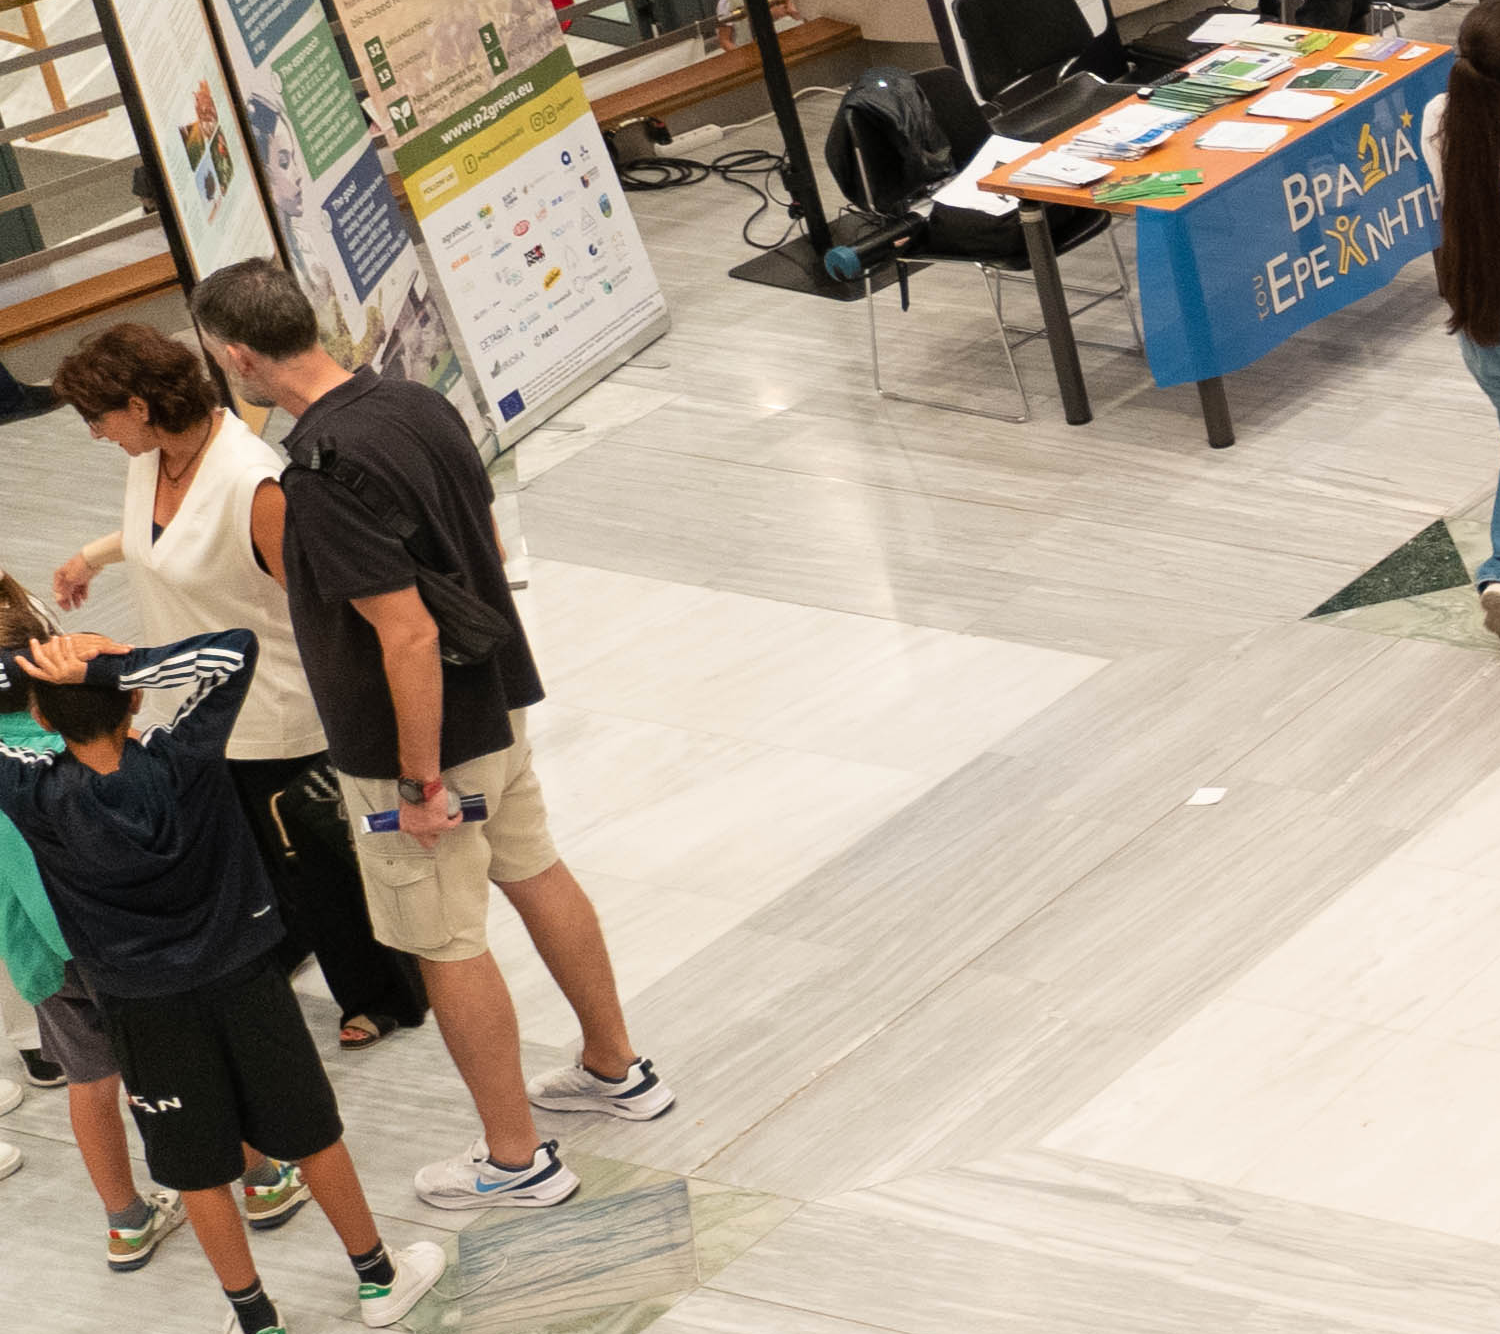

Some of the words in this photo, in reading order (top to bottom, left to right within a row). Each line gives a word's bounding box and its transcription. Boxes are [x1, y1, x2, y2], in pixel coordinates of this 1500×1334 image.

[483, 32, 493, 44] 3
[368, 44, 383, 59] 32
[378, 69, 393, 84] 13
[440, 80, 535, 146] www.p2green.eu
